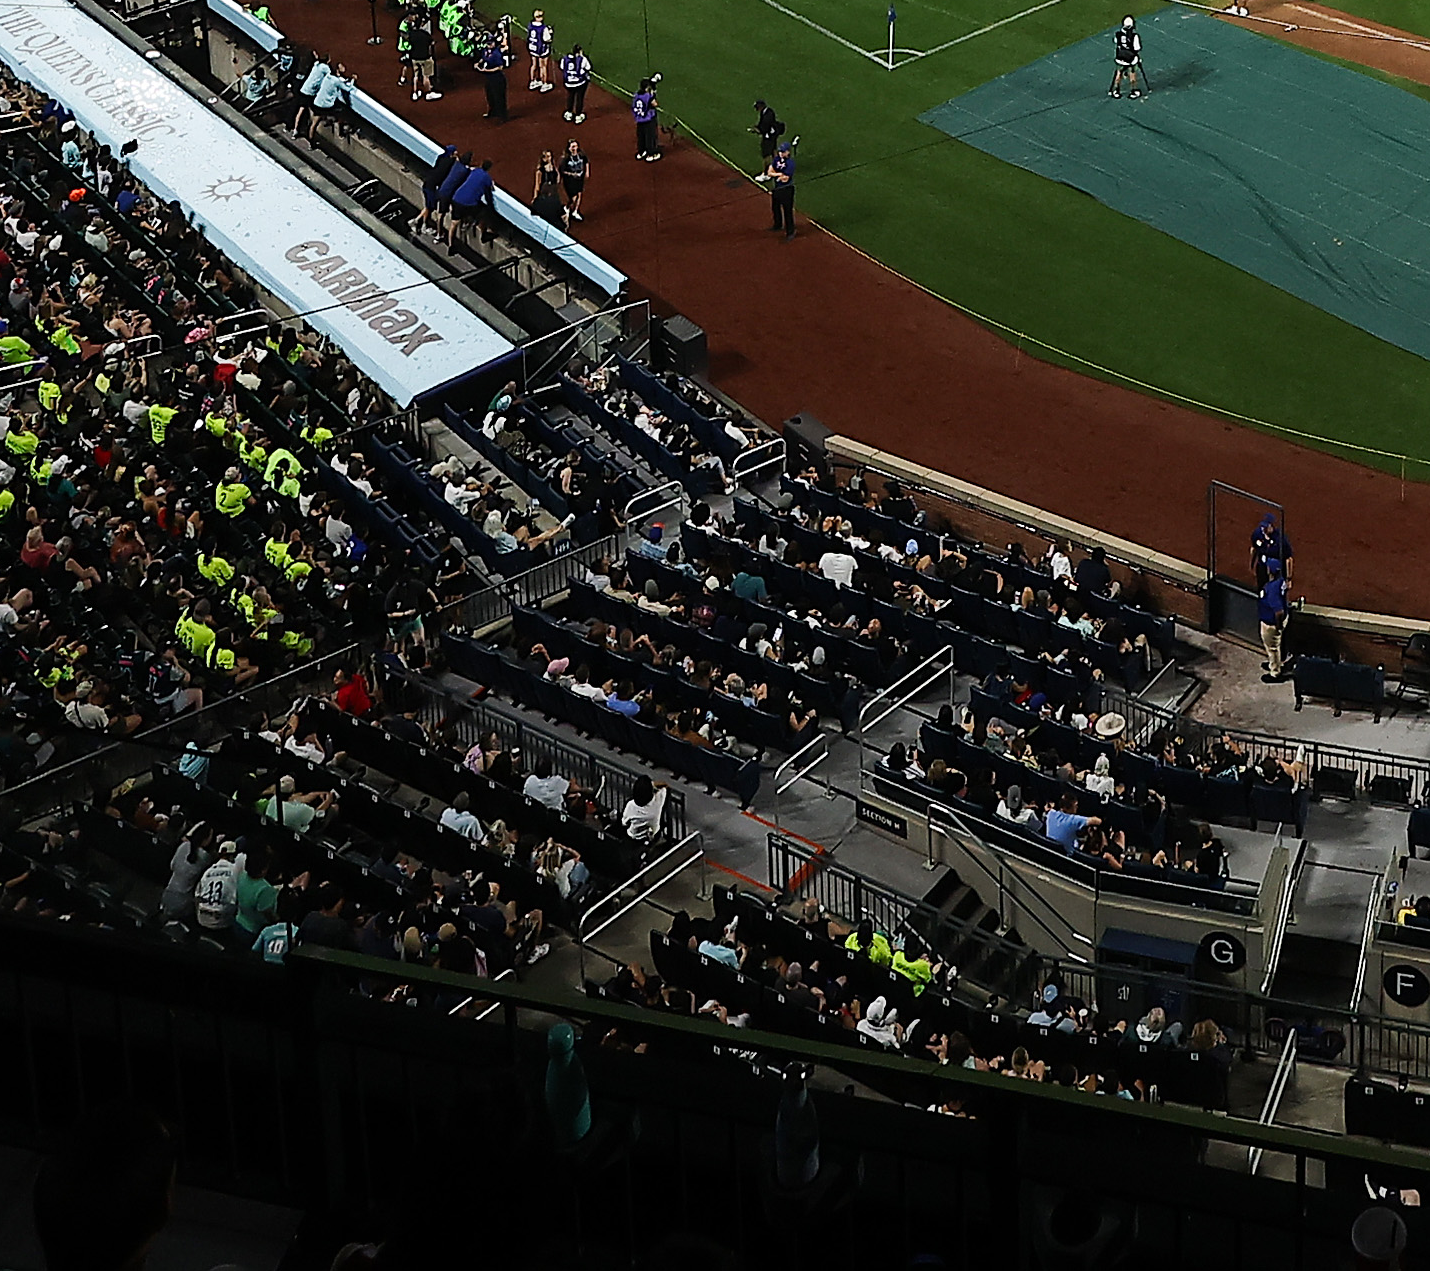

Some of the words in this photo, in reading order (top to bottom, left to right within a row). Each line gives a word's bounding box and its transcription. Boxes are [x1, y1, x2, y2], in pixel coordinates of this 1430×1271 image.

[16, 28, 107, 86] QUEENS
[861, 807, 893, 828] SECTION
[893, 821, 901, 831] H
[1210, 938, 1234, 968] G
[1395, 971, 1416, 998] F
